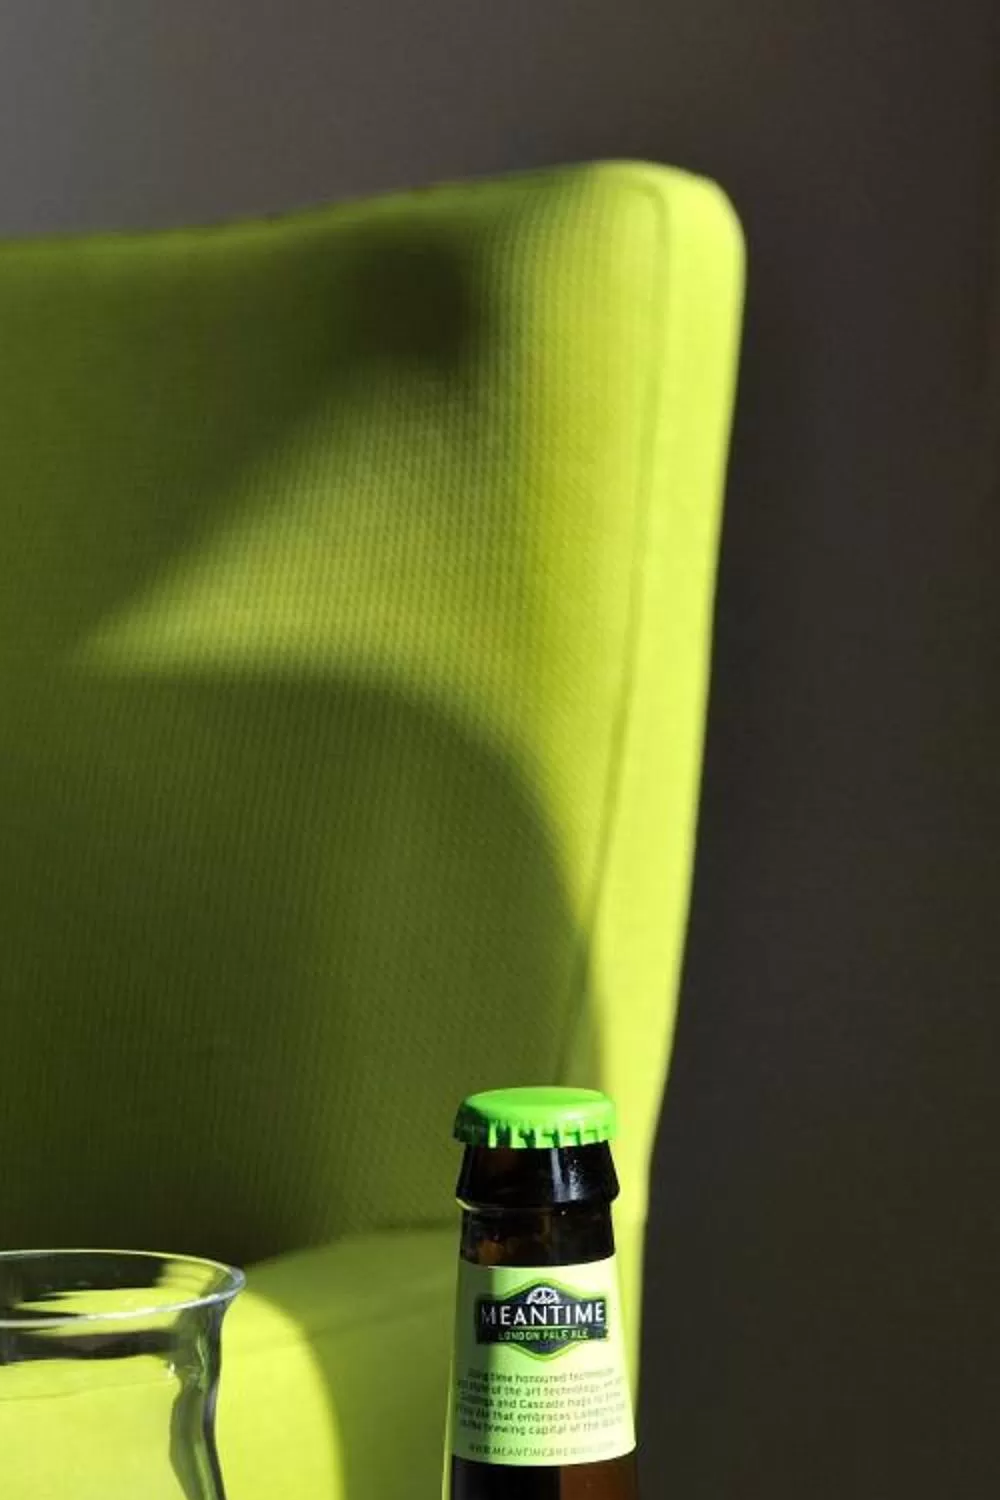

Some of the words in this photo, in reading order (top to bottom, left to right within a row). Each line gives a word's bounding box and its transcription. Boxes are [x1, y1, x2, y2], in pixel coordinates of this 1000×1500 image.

[480, 1301, 605, 1326] MEANTIME
[499, 1330, 540, 1342] LONDON
[543, 1329, 570, 1340] PALE
[571, 1327, 589, 1339] ALE
[519, 1399, 565, 1409] Cascade
